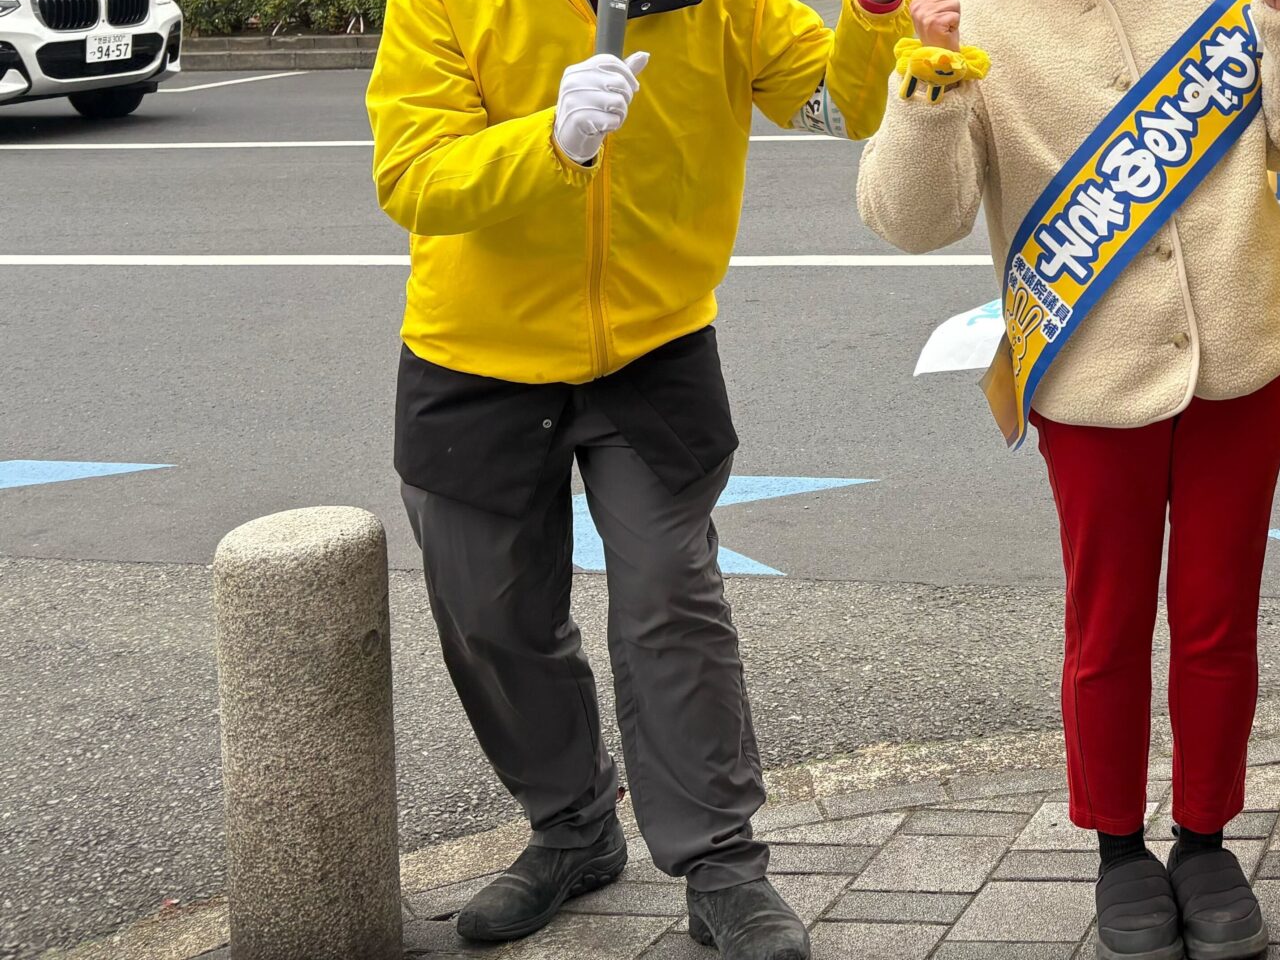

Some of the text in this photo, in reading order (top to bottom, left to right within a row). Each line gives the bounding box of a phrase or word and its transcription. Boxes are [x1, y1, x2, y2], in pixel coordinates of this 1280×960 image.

[97, 43, 129, 60] 94-57
[1013, 255, 1071, 325] 衆議院議員
